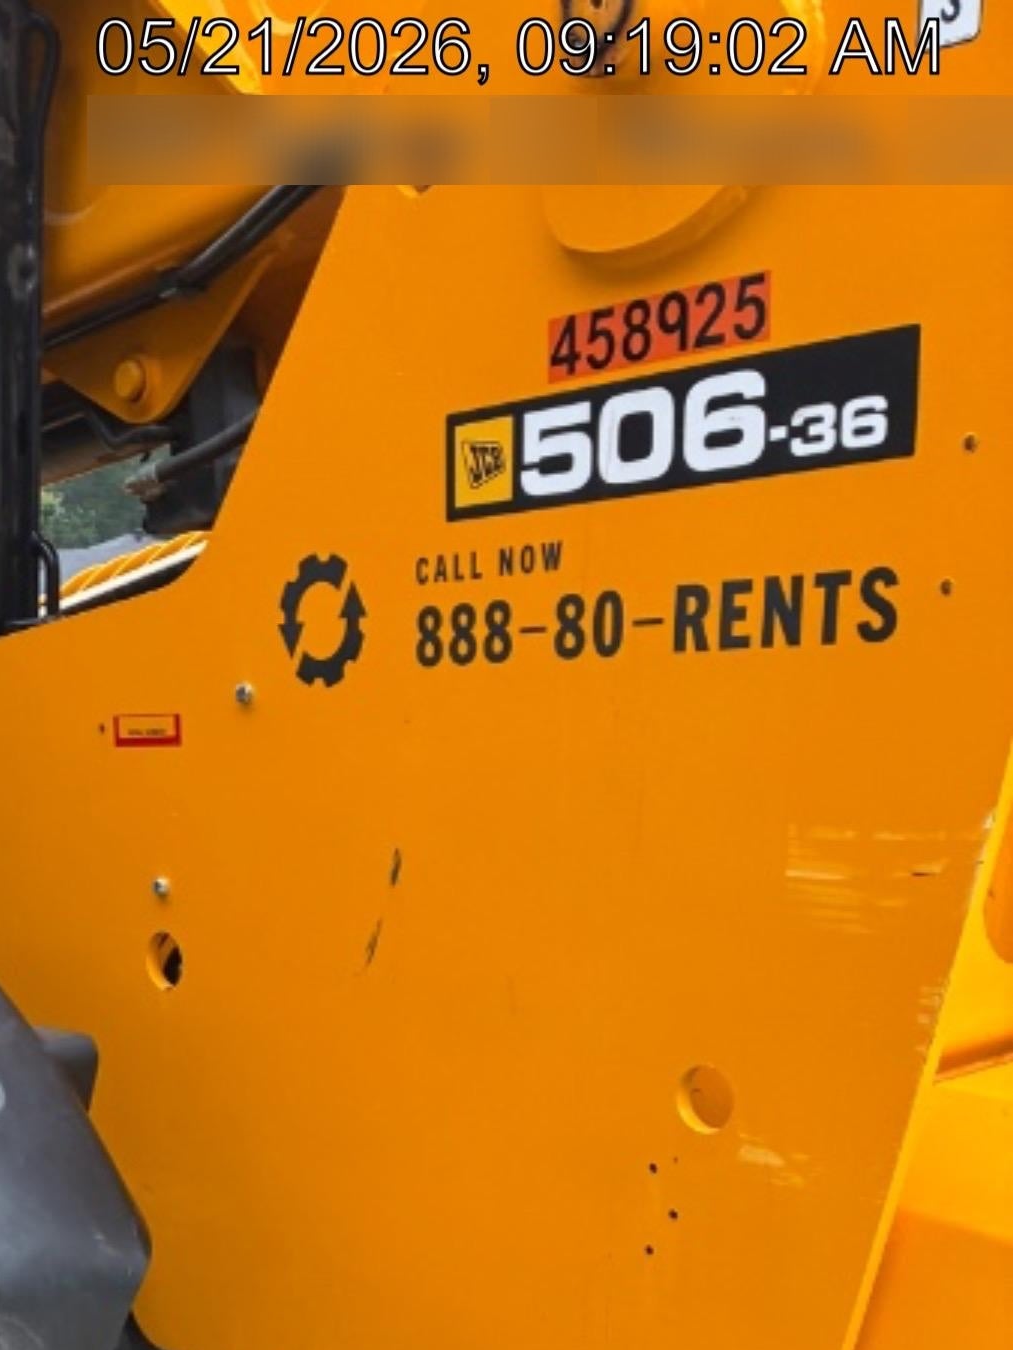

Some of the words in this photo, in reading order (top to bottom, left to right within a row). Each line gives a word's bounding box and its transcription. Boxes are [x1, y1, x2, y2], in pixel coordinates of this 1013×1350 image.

[549, 272, 767, 376] 458925
[468, 444, 505, 484] JCB
[520, 369, 889, 497] 506-36
[416, 551, 483, 585] CALL
[499, 540, 563, 577] NOW
[416, 566, 900, 669] 888-80-RENTS
